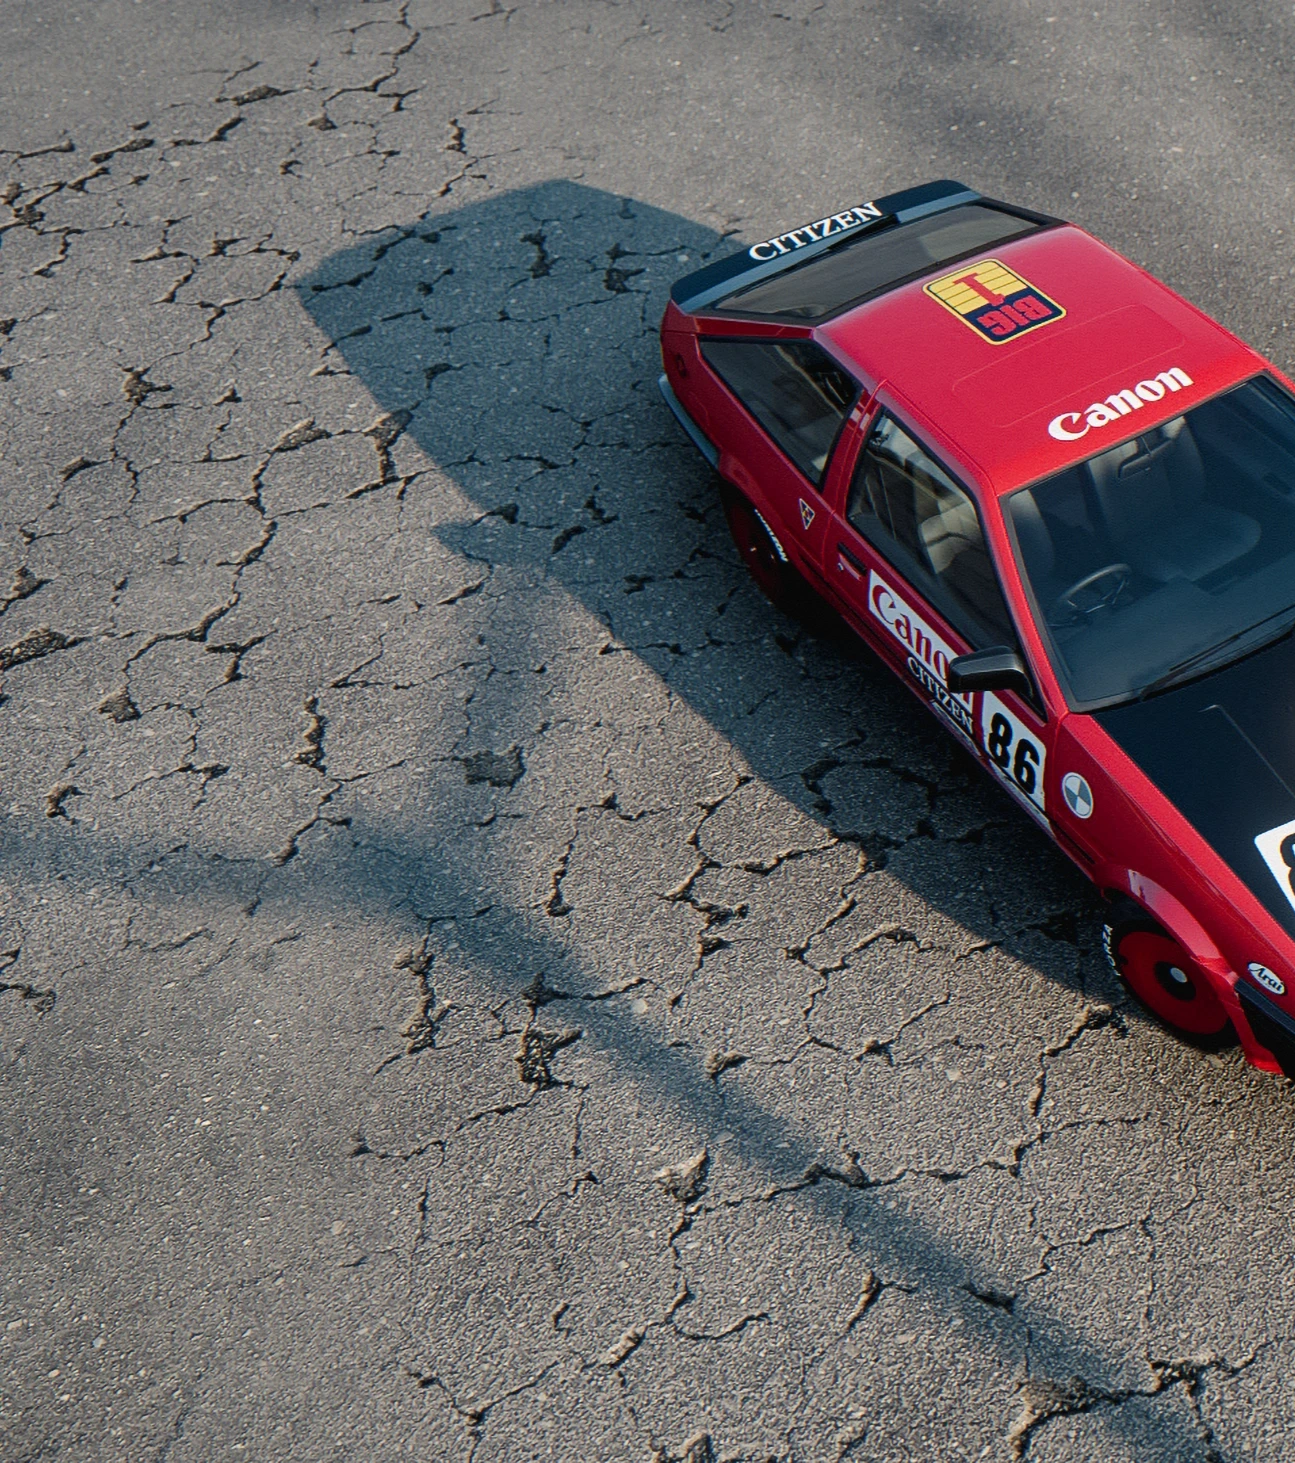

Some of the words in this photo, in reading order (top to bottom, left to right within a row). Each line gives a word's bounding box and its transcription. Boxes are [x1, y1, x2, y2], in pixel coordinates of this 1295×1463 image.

[748, 200, 883, 261] CITIZEN
[976, 295, 1053, 336] BIG
[1047, 367, 1194, 442] Canon
[873, 584, 973, 709] Cano
[907, 656, 973, 736] CITIZEN
[988, 712, 1041, 796] 86
[1249, 966, 1284, 992] Arai
